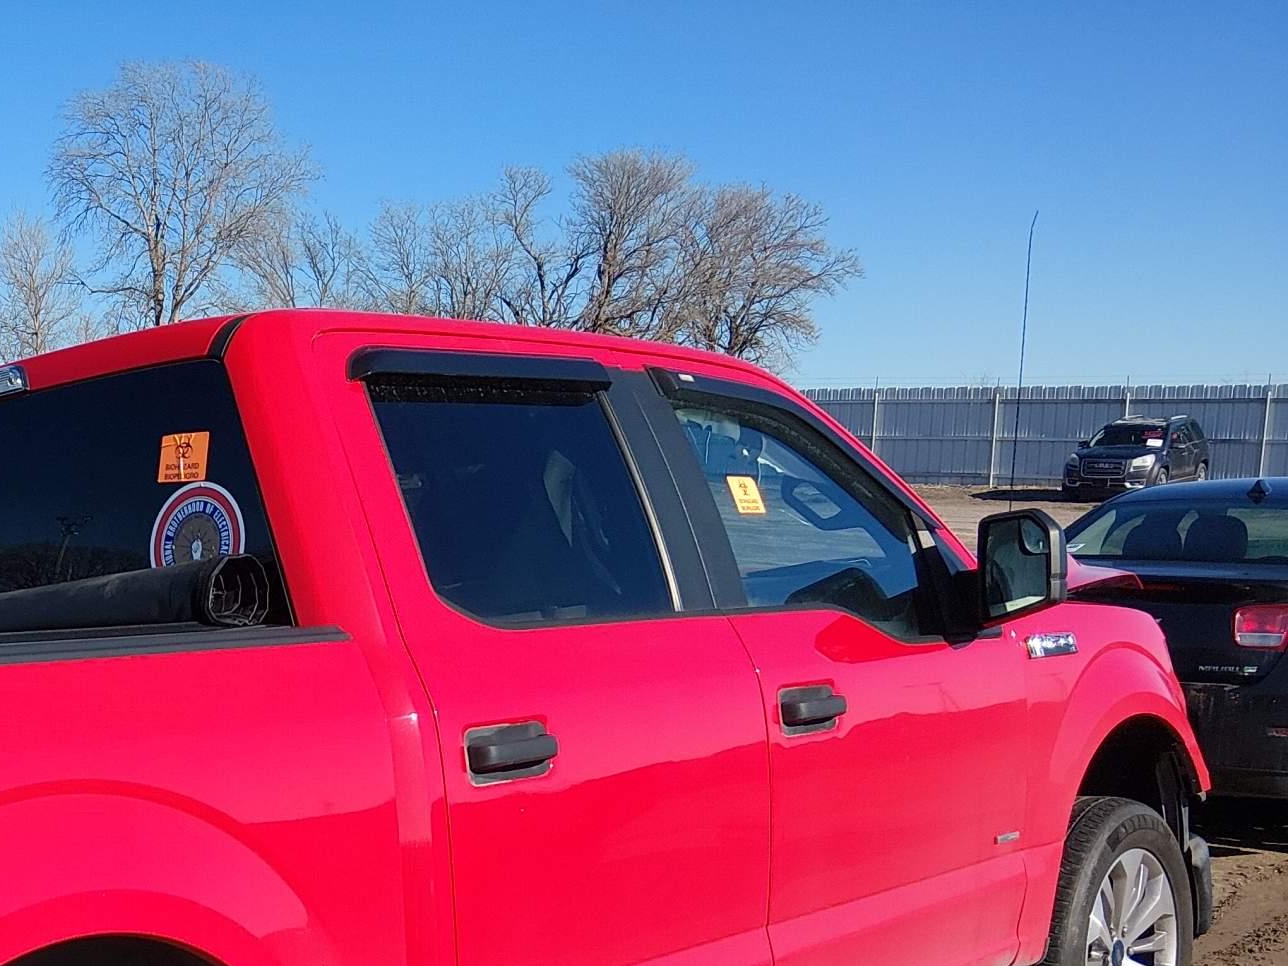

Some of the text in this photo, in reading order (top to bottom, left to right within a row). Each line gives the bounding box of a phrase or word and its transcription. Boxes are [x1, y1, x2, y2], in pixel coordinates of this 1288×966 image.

[165, 463, 200, 471] BIOHZARD
[164, 472, 199, 480] BIOPEIGRO
[167, 501, 204, 537] BROTHERHOOD
[205, 503, 214, 514] OF
